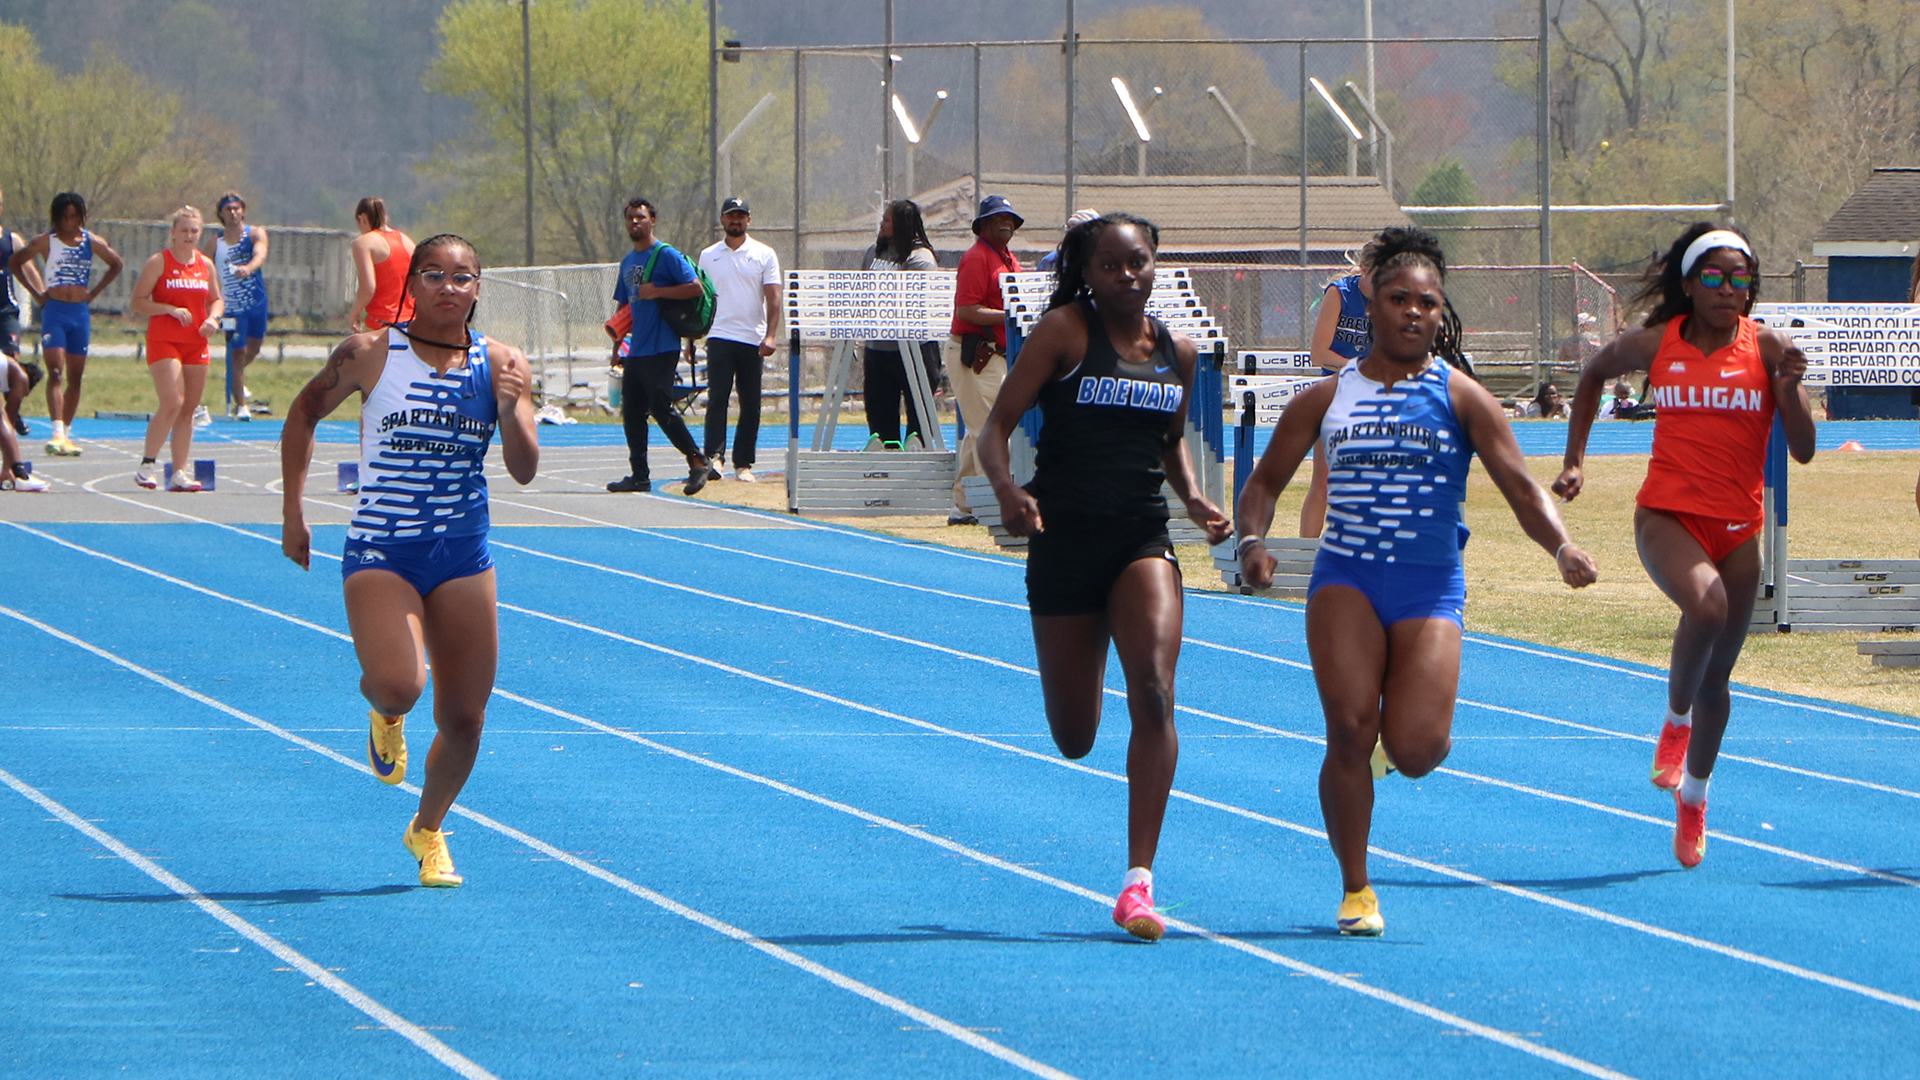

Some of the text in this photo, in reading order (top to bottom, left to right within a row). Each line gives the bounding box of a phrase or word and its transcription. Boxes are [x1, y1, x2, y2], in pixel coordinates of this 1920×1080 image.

[828, 273, 876, 281] BREVARD
[879, 273, 927, 281] COLLEGE
[829, 281, 877, 291] BREVARD
[879, 281, 927, 292] COLLEGE
[829, 308, 877, 319] BREVARD
[879, 309, 927, 320] COLLEGE
[830, 328, 879, 339] BREVARD
[880, 328, 929, 340] COLLEGE
[1818, 330, 1884, 340] BREVARD
[1829, 342, 1895, 353] BREVARD
[1830, 355, 1896, 367] BREVARD
[1832, 369, 1898, 384] BREVARD
[1262, 389, 1289, 399] UCS
[1653, 385, 1762, 412] MILLIGAN
[381, 408, 490, 440] SPARTANBUR
[1328, 421, 1440, 454] SPARTANBURG
[1854, 573, 1888, 581] UCS
[1868, 586, 1902, 595] UCS
